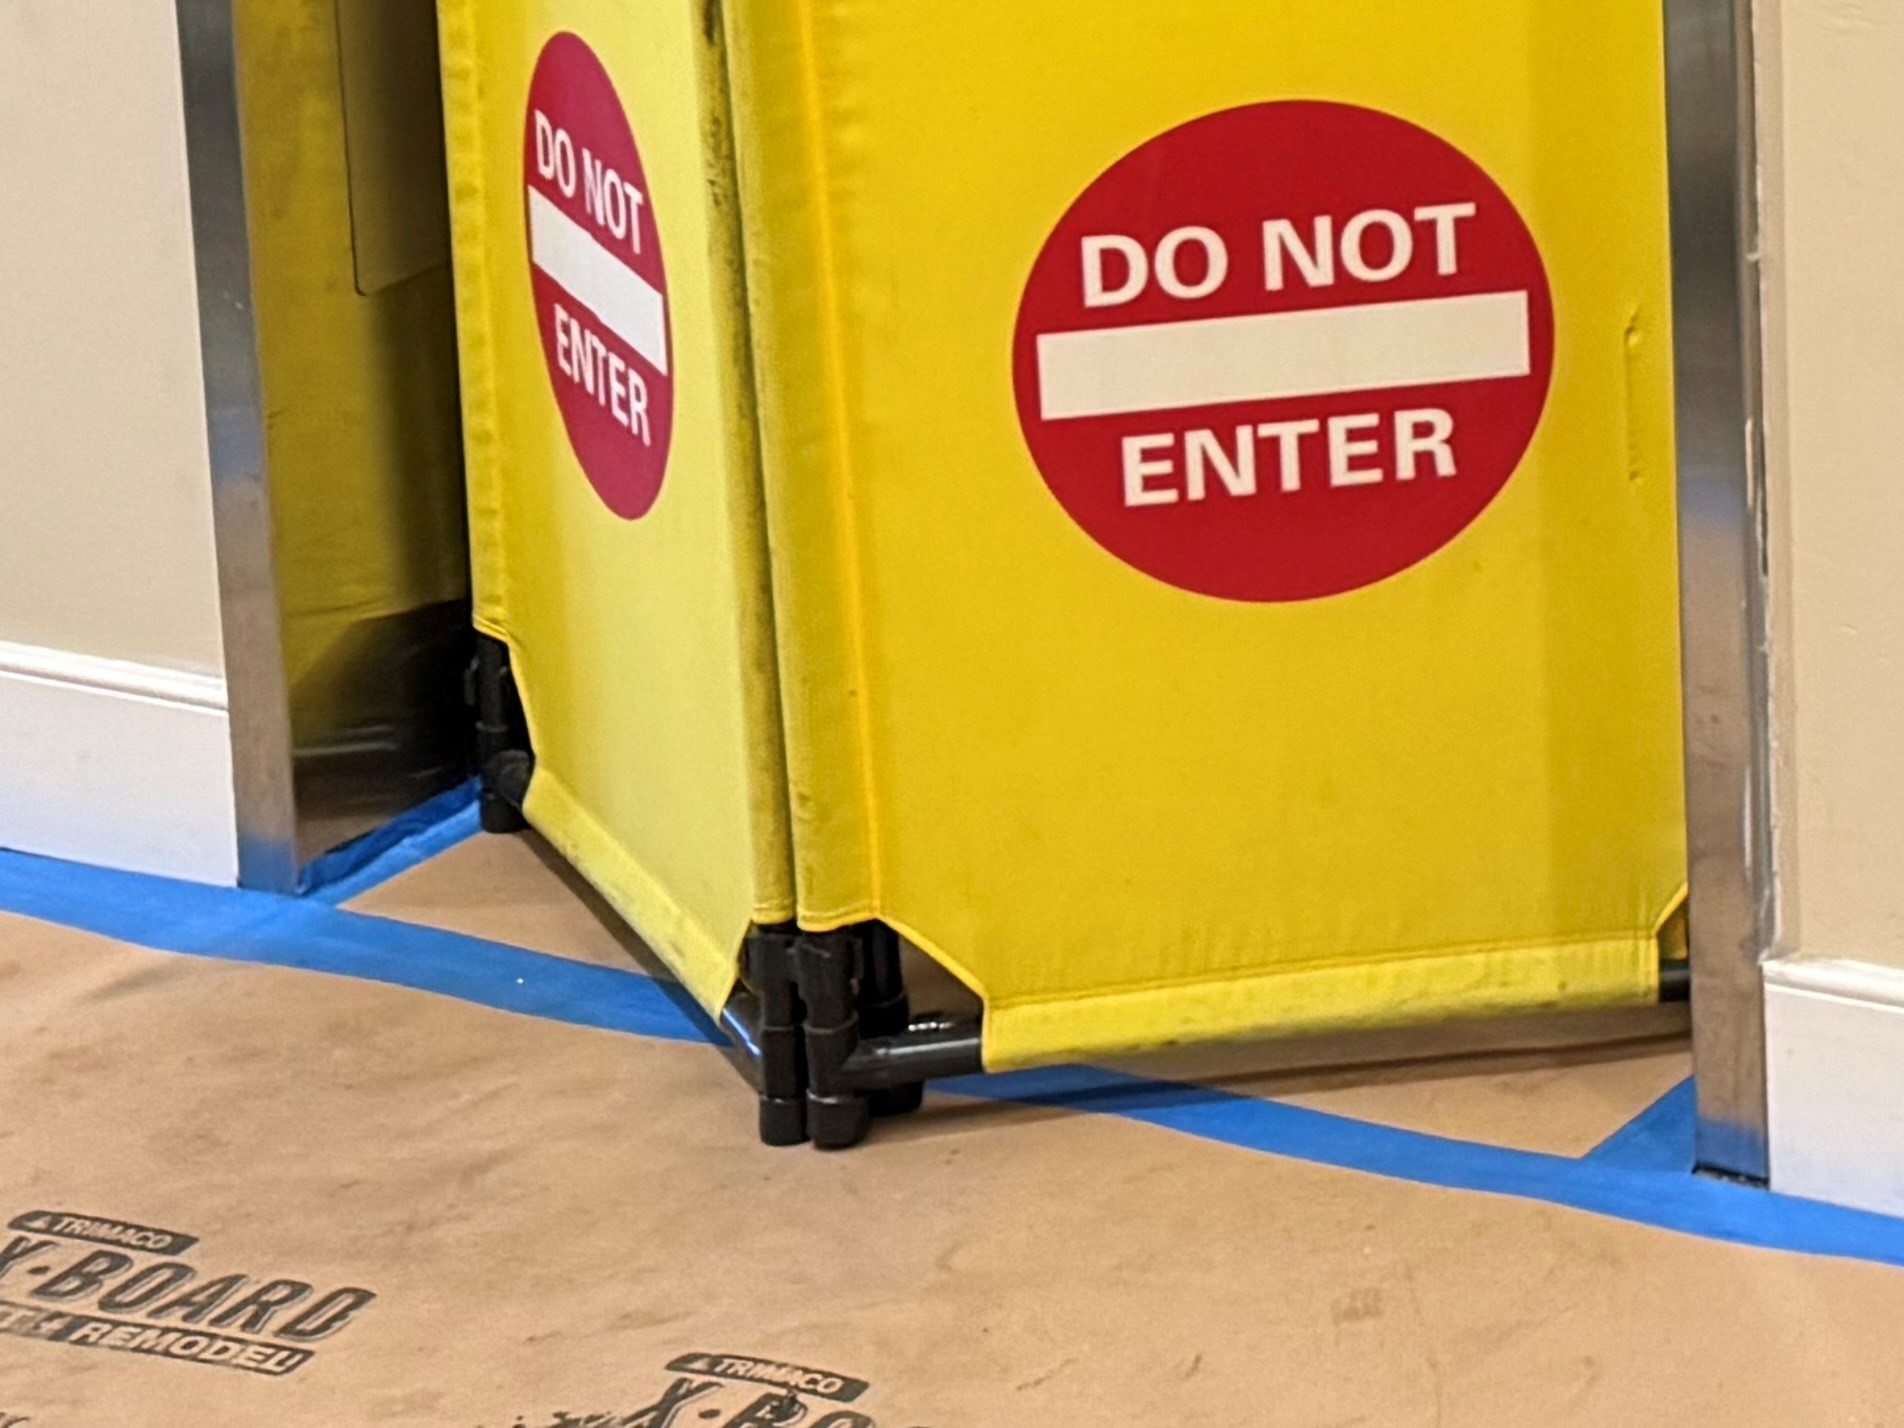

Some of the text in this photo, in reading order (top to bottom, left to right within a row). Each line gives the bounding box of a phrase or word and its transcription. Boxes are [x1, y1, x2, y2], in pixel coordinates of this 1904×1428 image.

[533, 108, 645, 255] DO NOT
[1080, 201, 1477, 309] DO NOT
[553, 302, 652, 448] ENTER
[1121, 407, 1457, 508] ENTER
[51, 1216, 173, 1250] TRIMACO
[713, 1357, 846, 1394] TRIMACO
